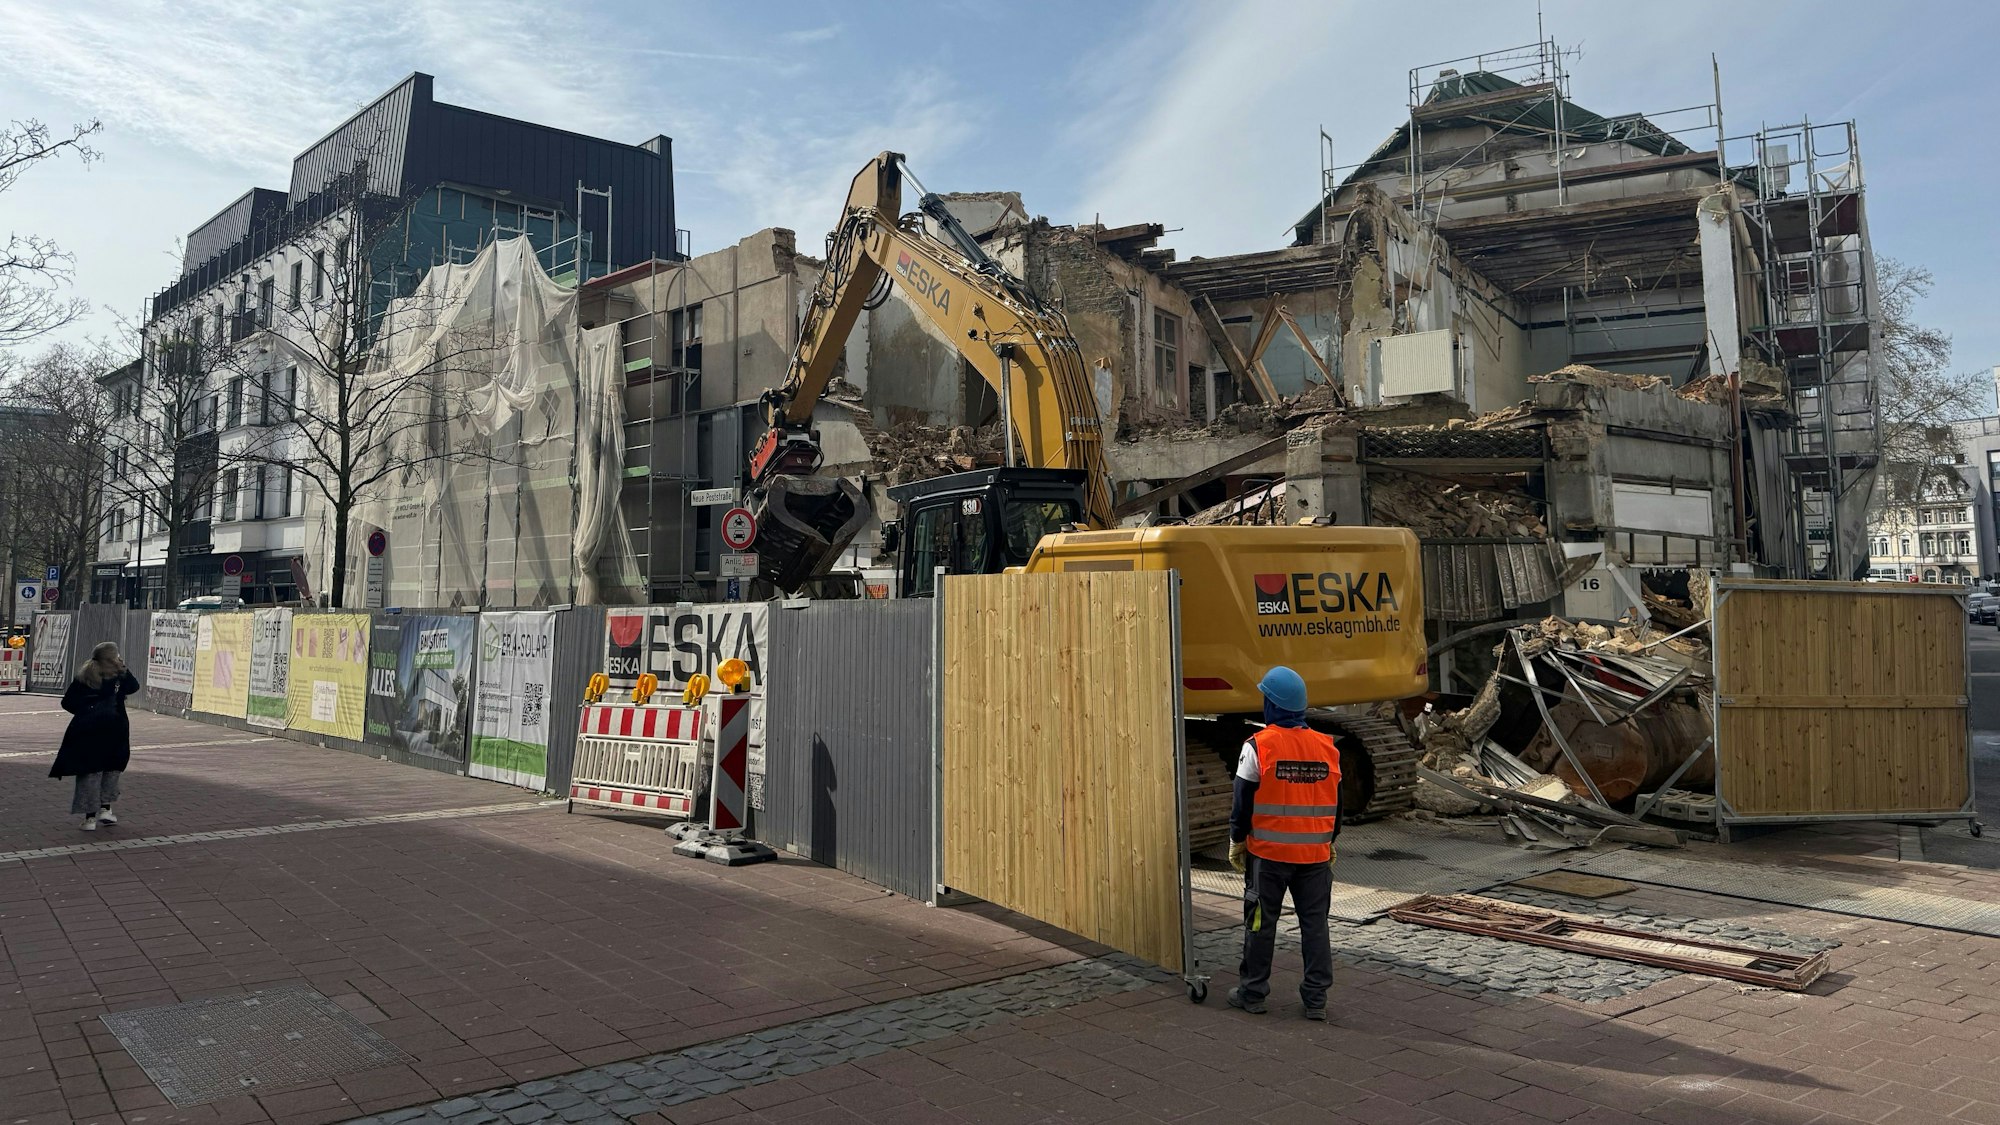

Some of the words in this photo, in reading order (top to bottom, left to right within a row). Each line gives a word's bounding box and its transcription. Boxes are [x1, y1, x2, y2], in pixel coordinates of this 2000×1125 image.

[907, 259, 950, 316] ESKA
[693, 494, 704, 502] Neue
[705, 491, 732, 502] Poststraße
[962, 499, 977, 515] 330
[1291, 572, 1399, 614] ESKA
[1580, 578, 1600, 590] 16
[1257, 601, 1290, 614] ESKA
[1258, 614, 1400, 639] www.eskagmbh.de
[421, 632, 447, 651] BAUSTOFFE
[501, 633, 548, 659] ERA-SOLAR
[647, 612, 763, 686] ESKA
[155, 646, 172, 665] ESKA
[40, 661, 63, 678] ESKA
[609, 656, 640, 675] ESKA
[370, 667, 396, 699] ALLES.
[368, 718, 391, 737] Henrich
